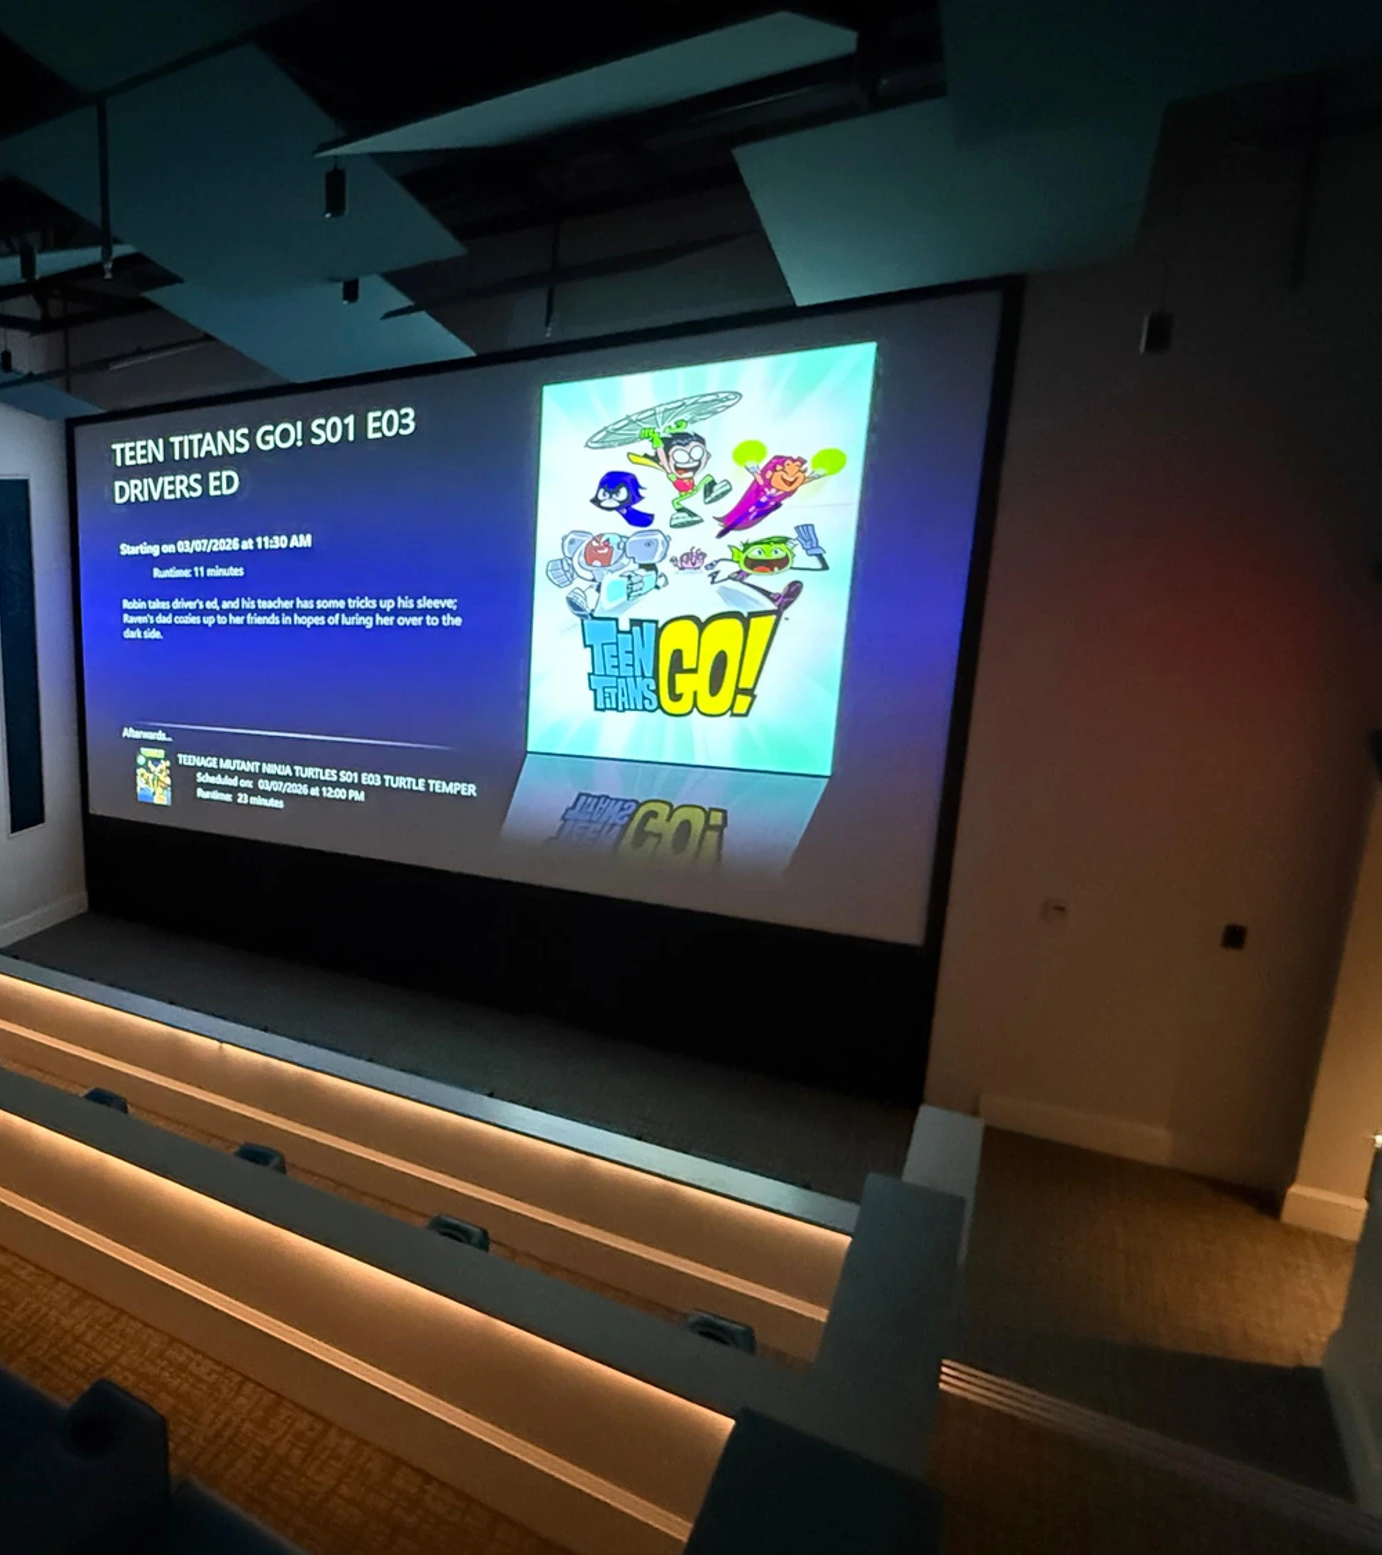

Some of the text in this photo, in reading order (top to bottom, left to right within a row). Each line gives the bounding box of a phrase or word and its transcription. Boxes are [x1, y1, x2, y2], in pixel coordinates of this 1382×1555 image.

[111, 407, 417, 467] TEEN TITANS GO! S01 E03
[113, 470, 240, 504] DRIVERS ED
[120, 533, 312, 557] Starting on 03/07/2026 at 11:30 AM
[153, 565, 245, 578] Runtime: 11 minutes
[122, 596, 458, 611] Robin takes driver's ed, and his teacher has some tricks up his sleeve;
[122, 613, 463, 629] Raven's dad cozies up to her friends in hopes of luring her over to the
[123, 628, 163, 639] dark side.
[582, 617, 657, 677] TEEN
[658, 613, 778, 716] GO!
[177, 753, 218, 769] TEENAGE
[219, 758, 260, 774] MUTANT
[261, 762, 292, 777] NINJA
[293, 765, 337, 781] TURTLES
[339, 770, 358, 784] S01
[361, 772, 382, 786] E03
[383, 775, 427, 792] TURTLE
[428, 779, 478, 797] TEMPER
[196, 772, 366, 802] Scheduled on: 03/07/2026 at 12:00 PM
[196, 787, 285, 809] Runtime: 23 minutes
